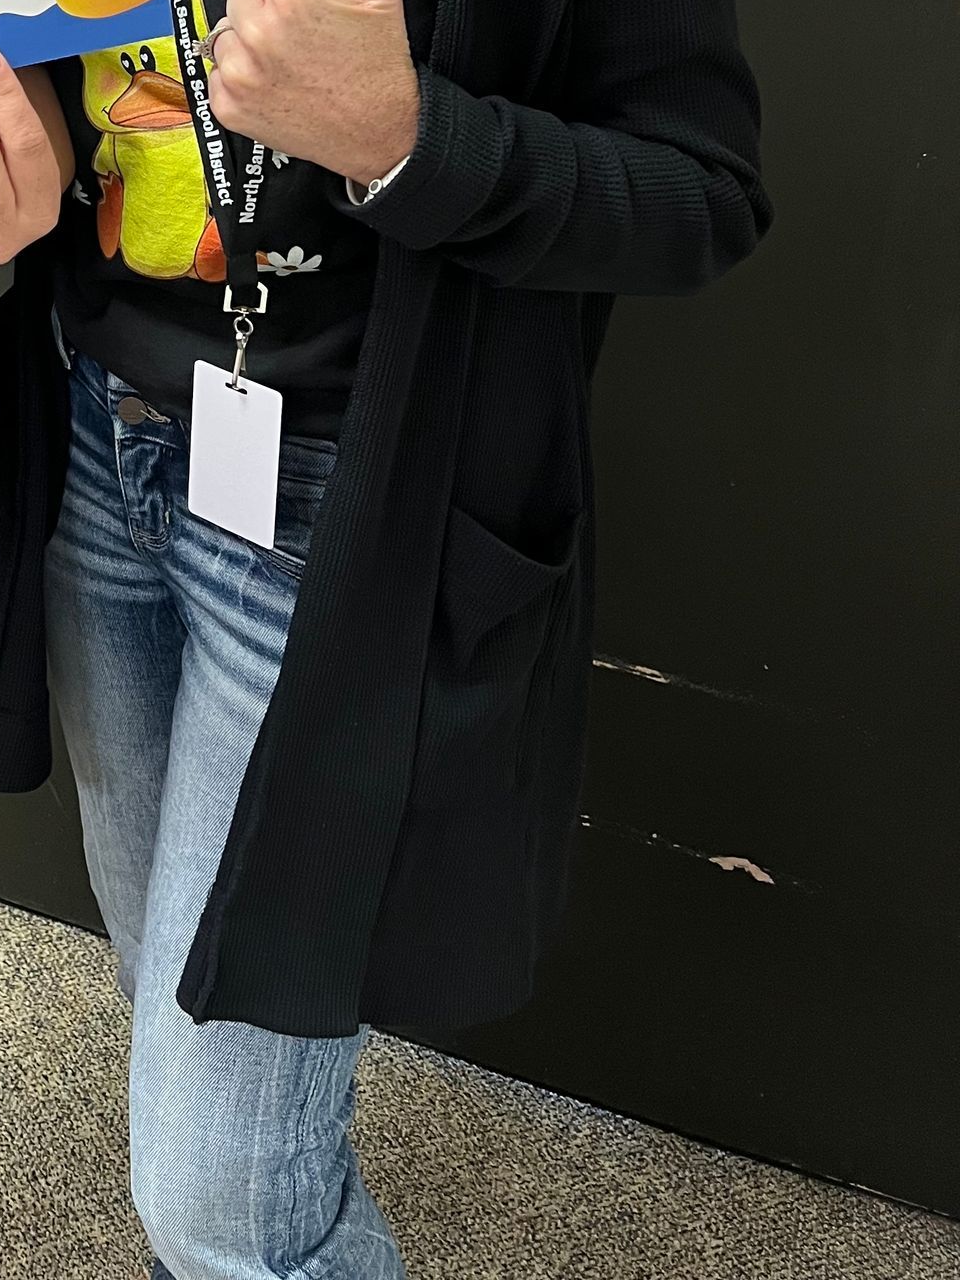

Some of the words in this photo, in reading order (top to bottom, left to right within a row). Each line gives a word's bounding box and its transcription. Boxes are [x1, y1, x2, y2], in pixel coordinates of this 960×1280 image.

[176, 6, 197, 77] Sanpete
[190, 79, 219, 138] School
[206, 139, 234, 207] District
[239, 174, 265, 223] North
